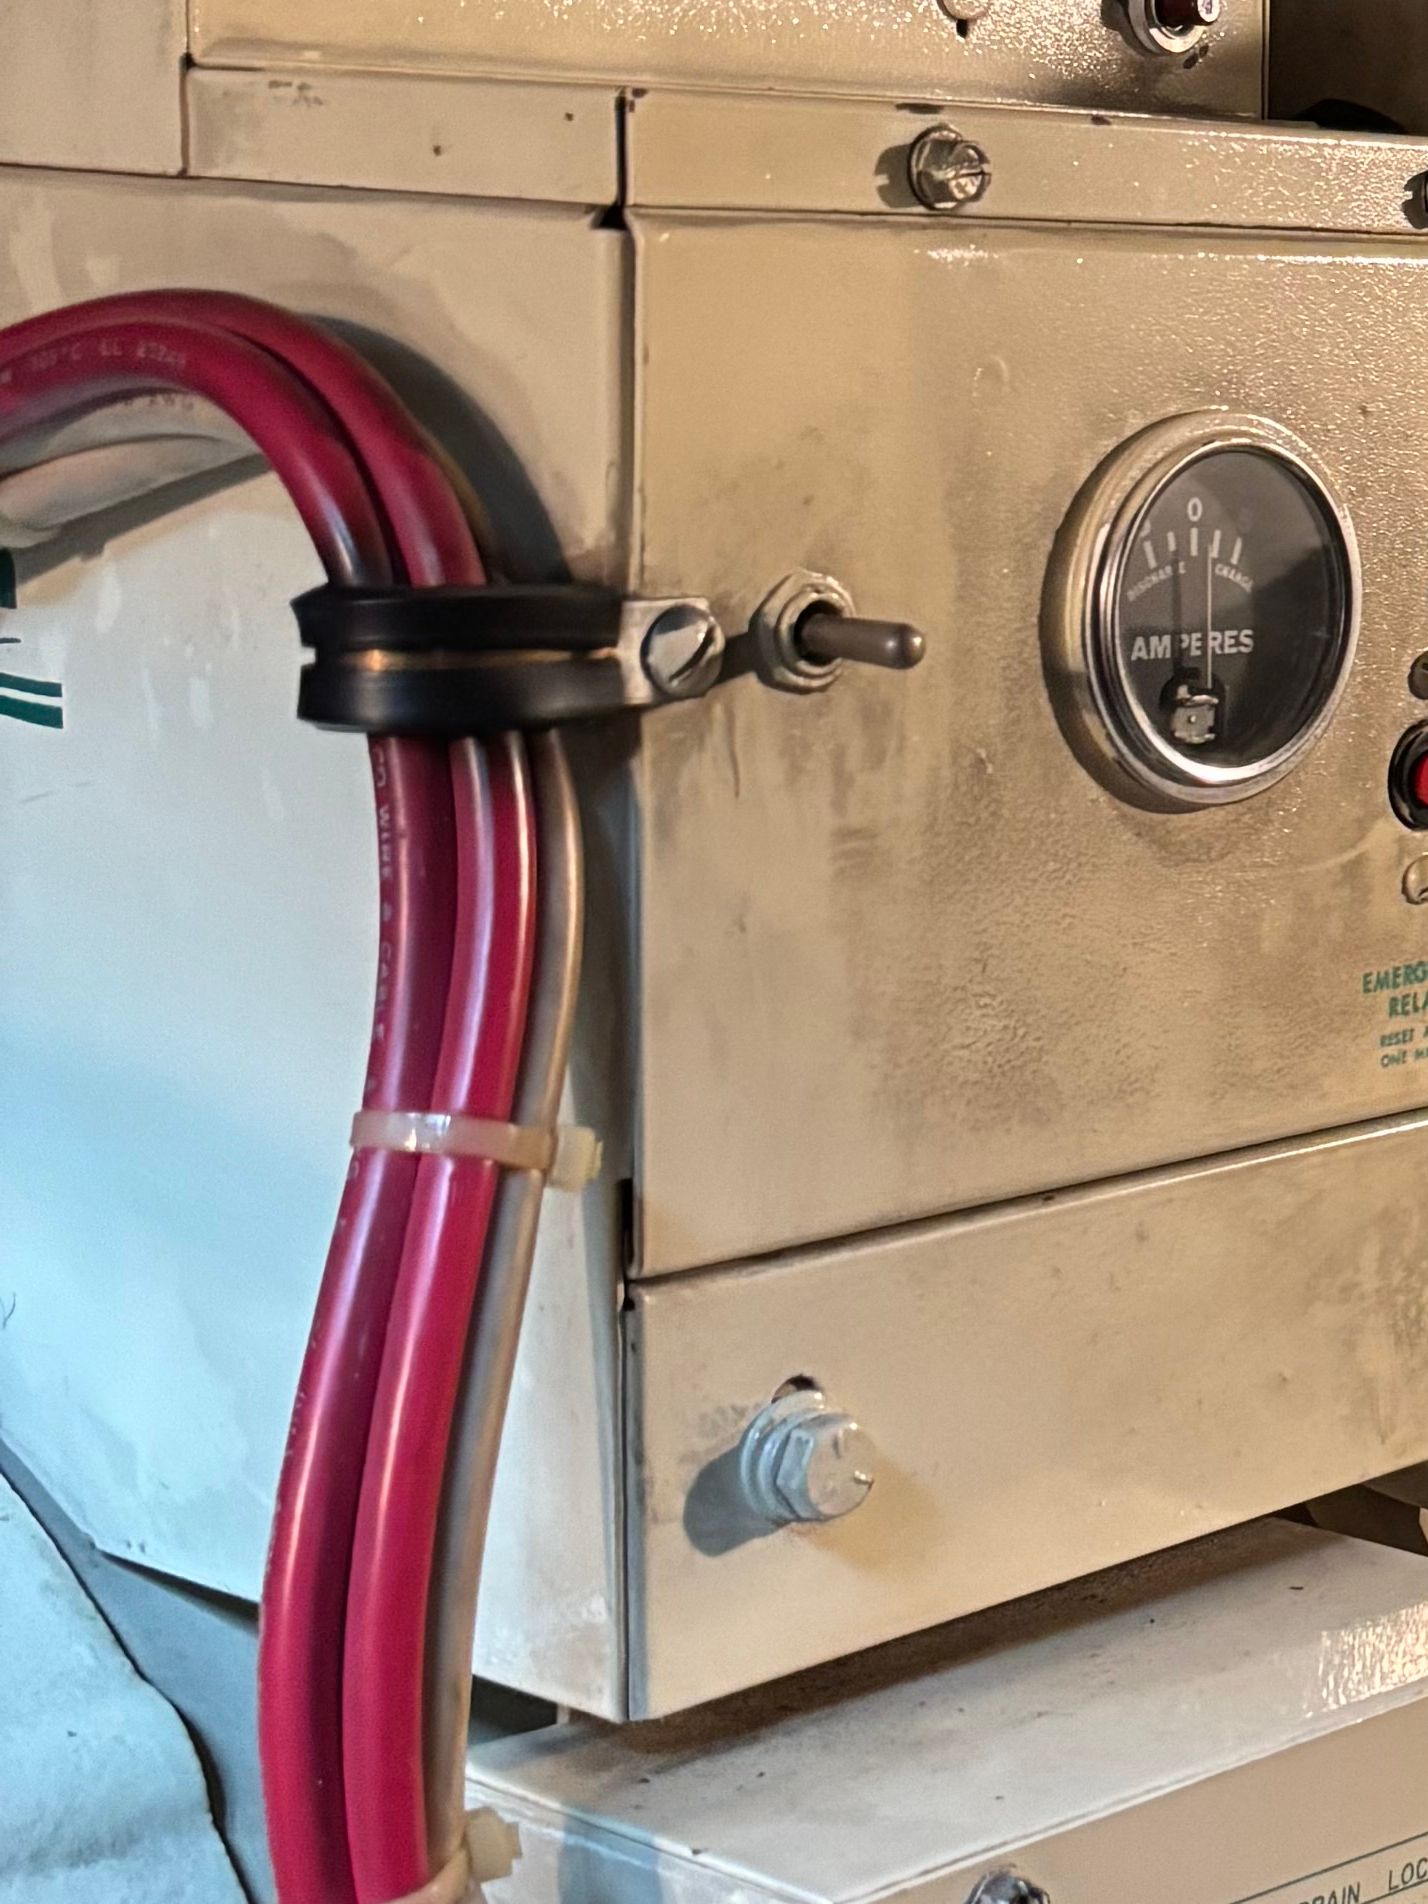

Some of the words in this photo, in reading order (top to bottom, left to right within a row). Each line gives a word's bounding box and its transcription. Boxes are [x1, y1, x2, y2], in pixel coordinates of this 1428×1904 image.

[1186, 496, 1204, 522] 0
[1127, 560, 1187, 602] DISCHARE
[1130, 629, 1255, 662] AMPERES
[1379, 1028, 1415, 1048] RESET
[1380, 1050, 1407, 1069] ONE
